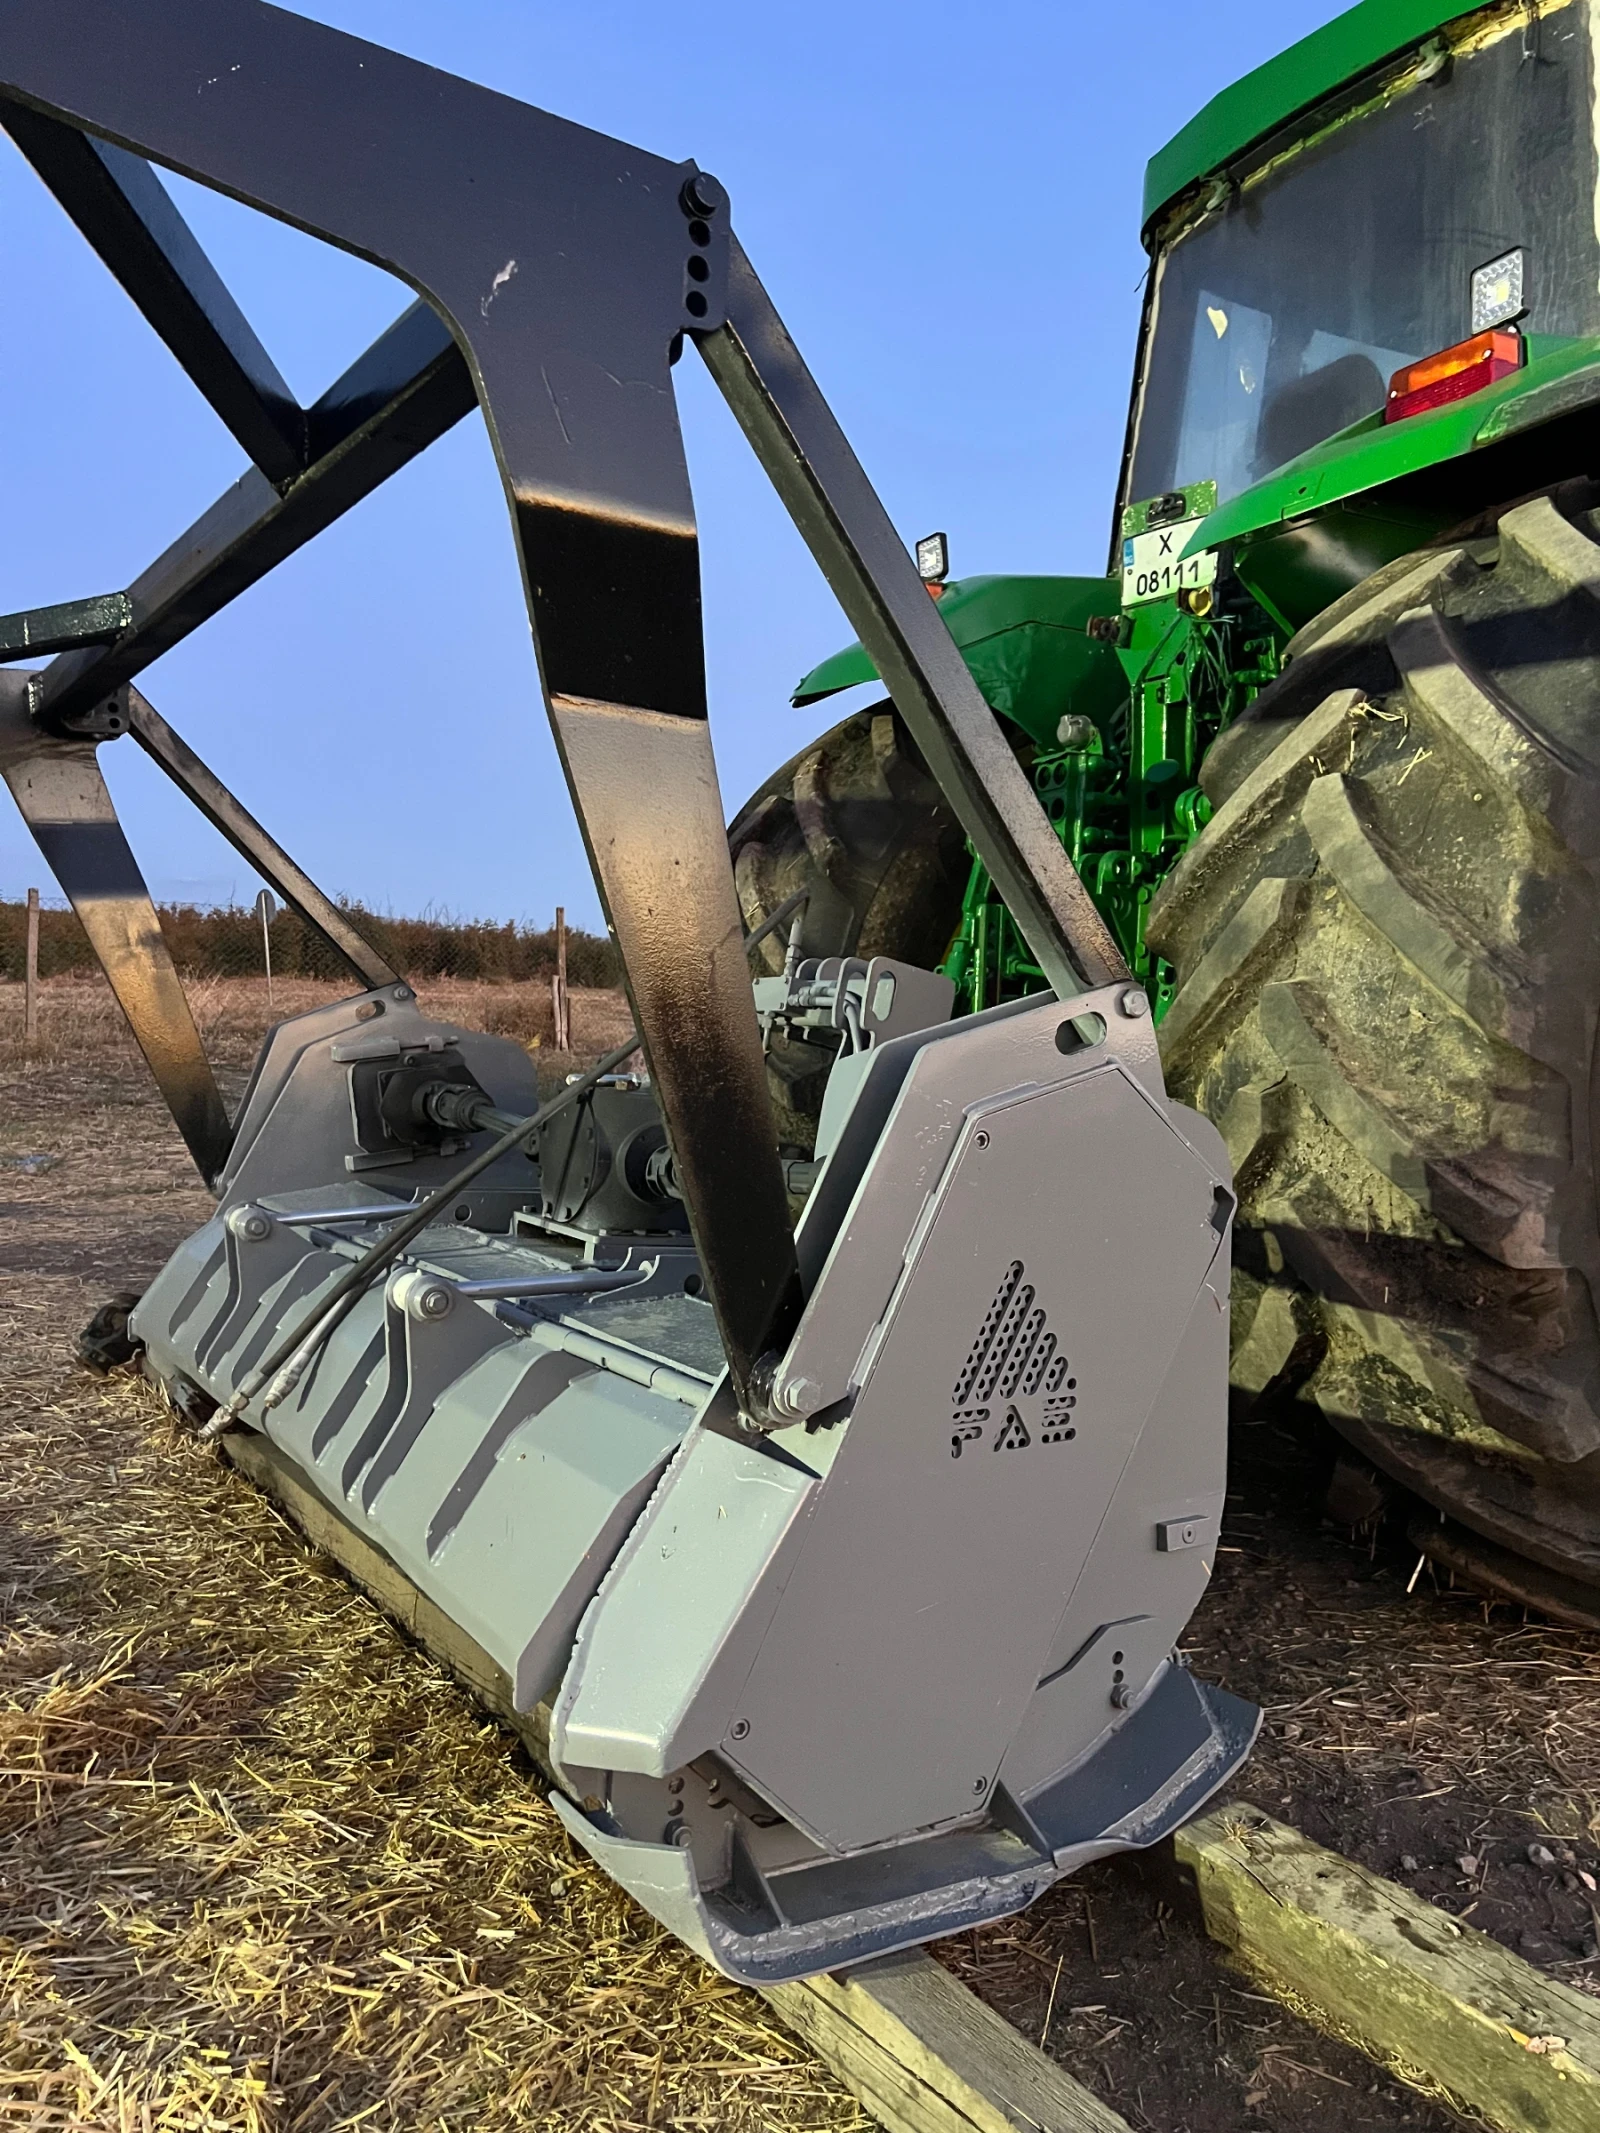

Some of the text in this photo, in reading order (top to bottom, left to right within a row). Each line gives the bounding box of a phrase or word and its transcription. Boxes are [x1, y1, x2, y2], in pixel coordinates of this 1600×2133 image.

[1159, 531, 1172, 556] X
[1136, 560, 1199, 596] 08111
[951, 1395, 1077, 1459] FAE
